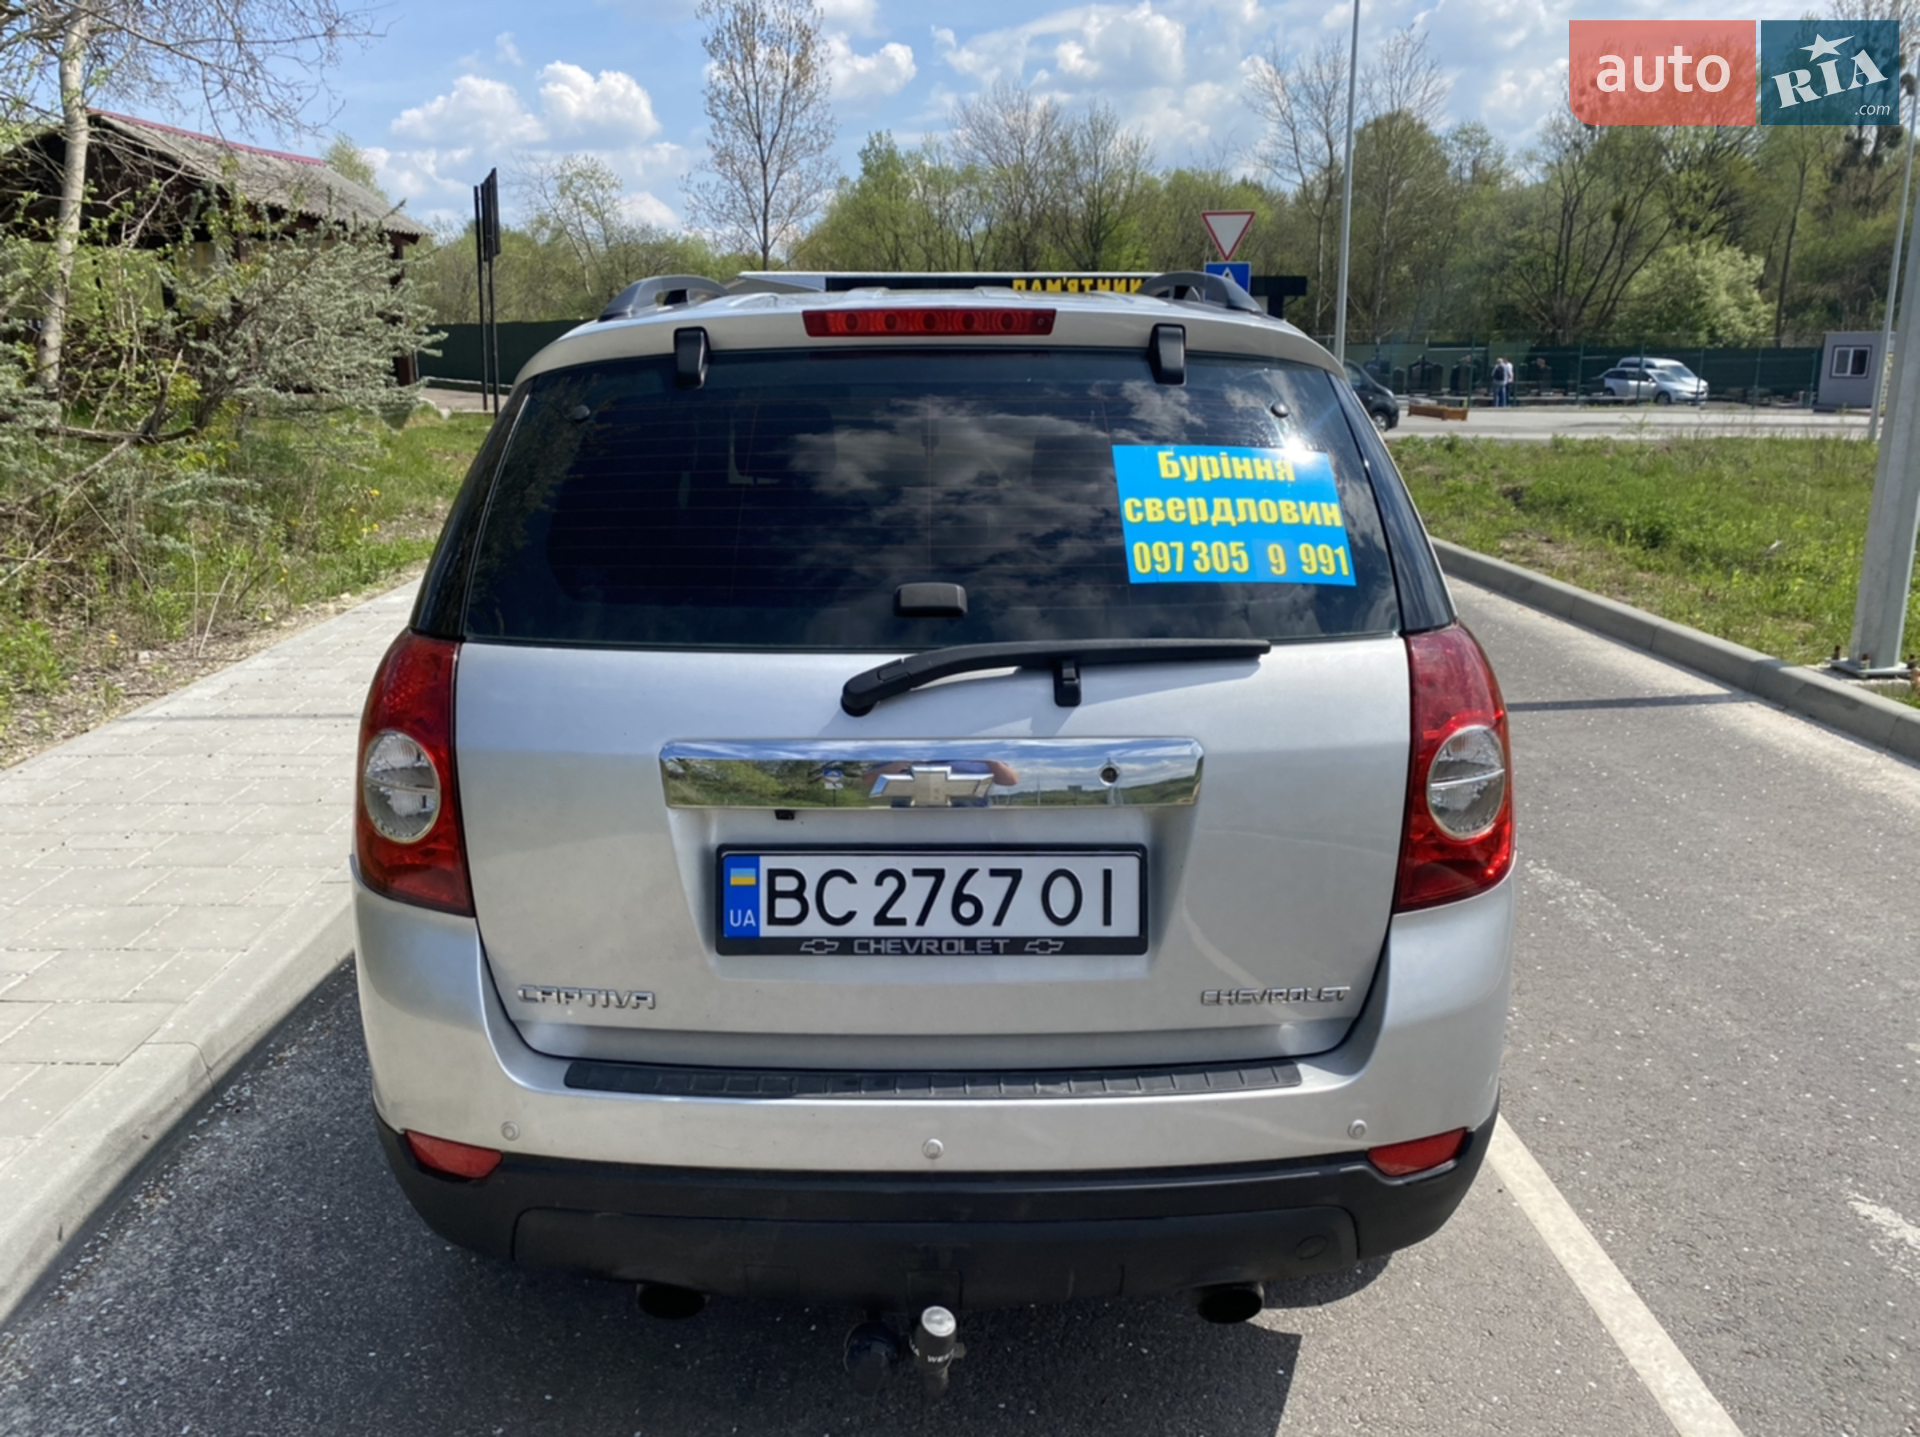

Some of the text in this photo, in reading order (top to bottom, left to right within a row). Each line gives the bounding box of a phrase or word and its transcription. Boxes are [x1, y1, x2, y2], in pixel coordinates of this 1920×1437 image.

[1157, 451, 1296, 482] Буріння
[1123, 497, 1343, 527] свердловин
[1133, 541, 1349, 576] 097 305 9 991
[766, 868, 1113, 927] BC 2767 OI
[729, 909, 756, 927] UA
[853, 939, 1010, 954] CHEVROLET
[517, 984, 656, 1010] CAPTIVA
[1201, 986, 1351, 1006] CHEVROLET
